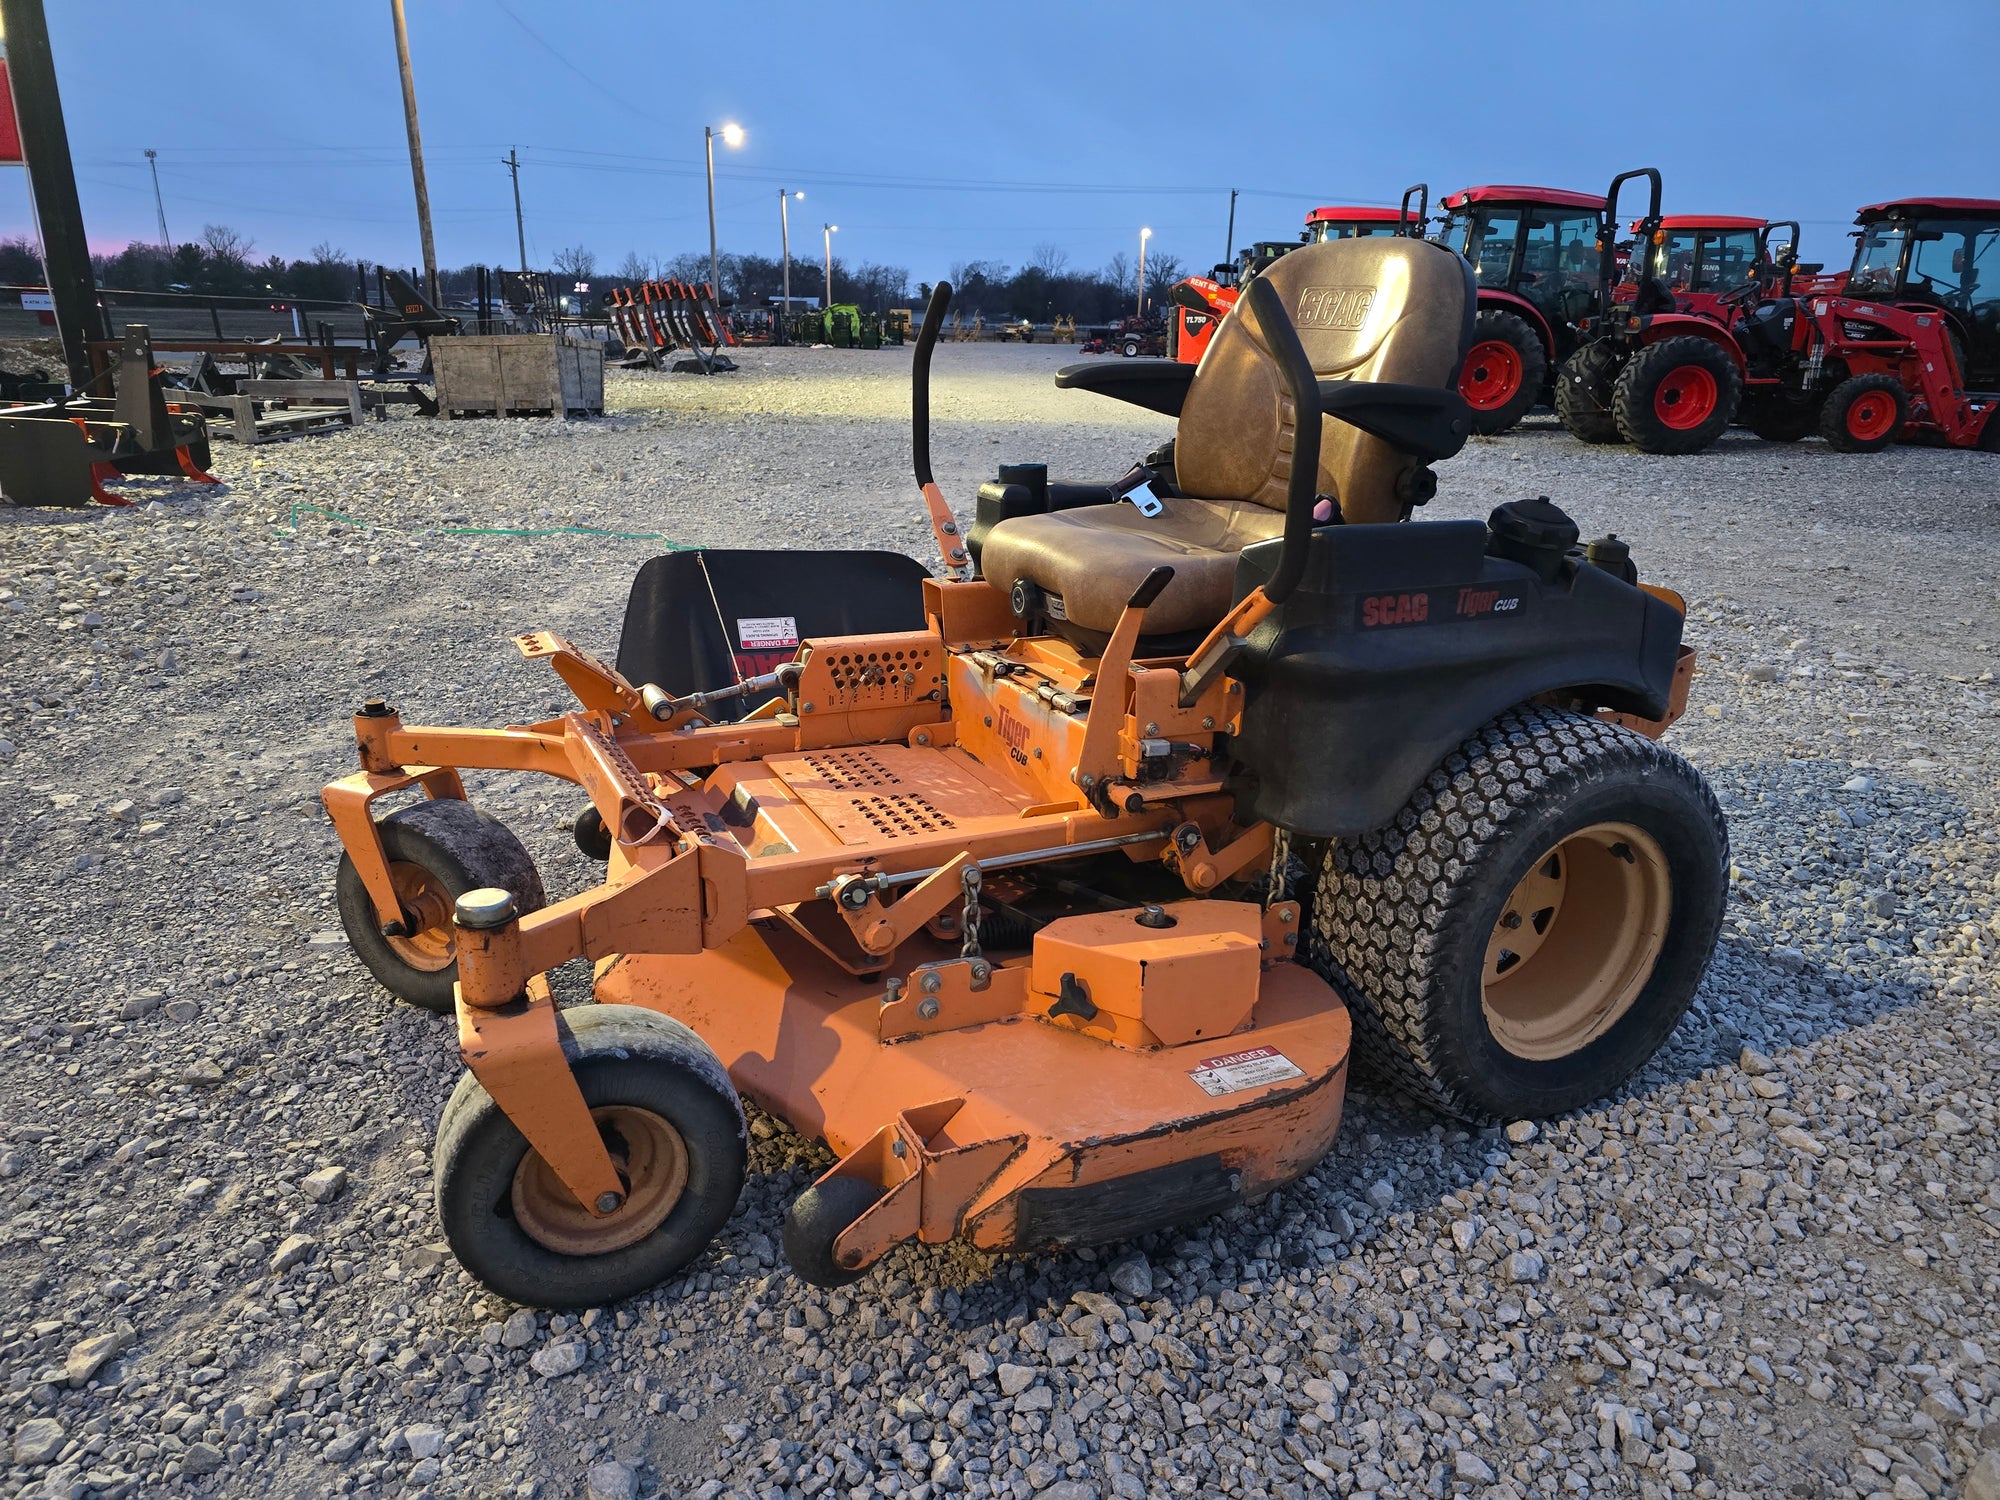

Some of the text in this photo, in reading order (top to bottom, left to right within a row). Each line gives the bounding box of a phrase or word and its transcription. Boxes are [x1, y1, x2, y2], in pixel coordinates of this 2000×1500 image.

[1190, 278, 1218, 292] RENT ME
[1298, 290, 1373, 327] SCAG
[1186, 316, 1206, 324] TL750
[1362, 588, 1519, 626] SCAG Tiger CUB
[750, 639, 781, 647] DANGER
[998, 704, 1030, 750] Tiger
[1010, 746, 1029, 767] CUB
[1210, 1049, 1270, 1067] DANGER
